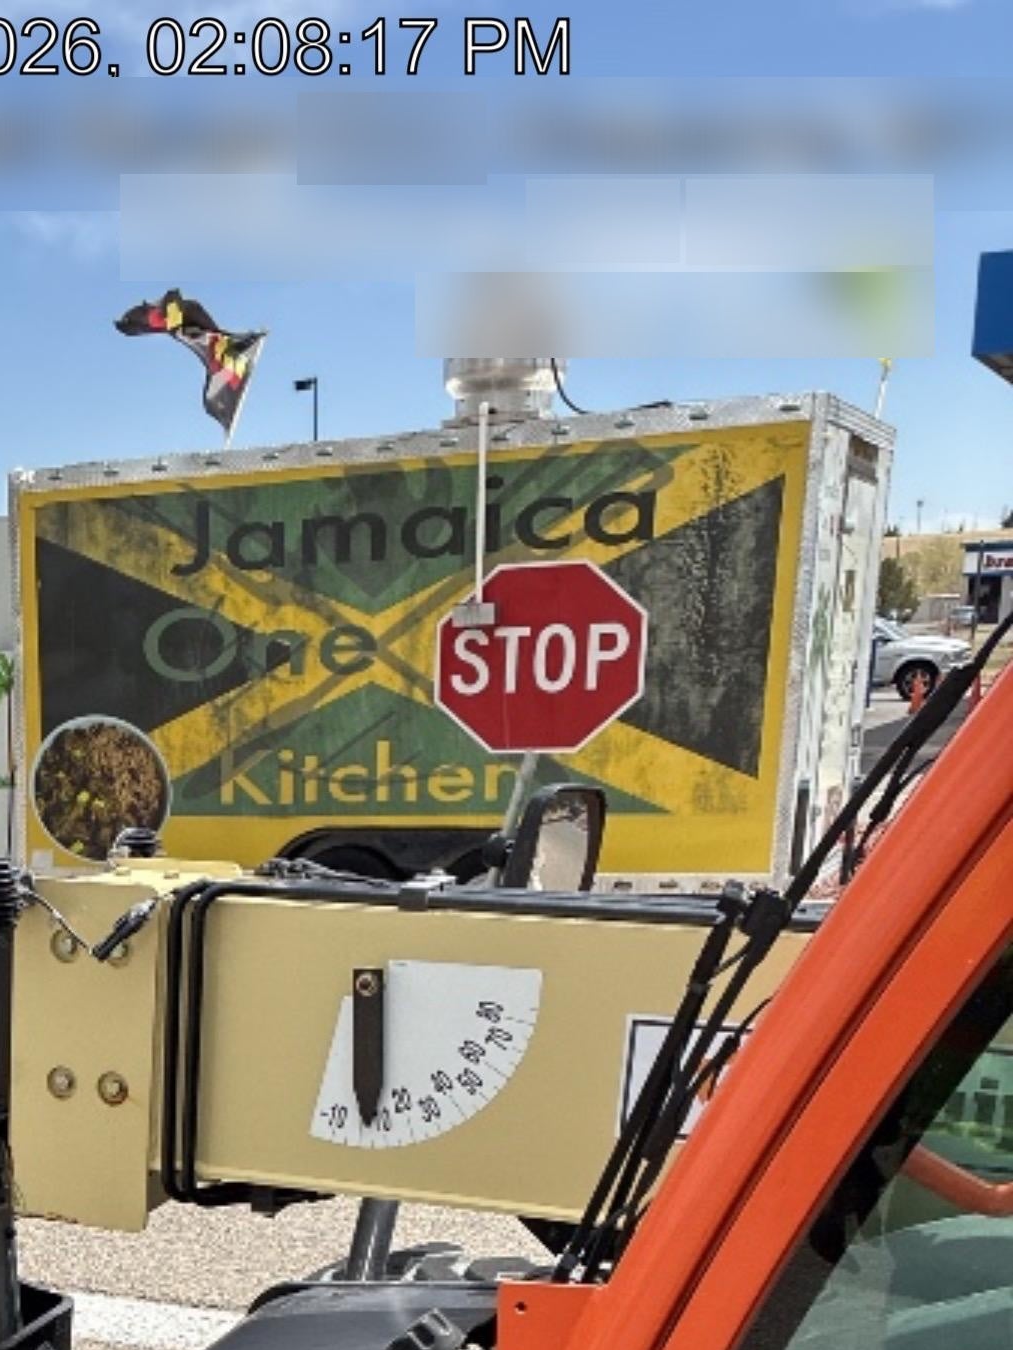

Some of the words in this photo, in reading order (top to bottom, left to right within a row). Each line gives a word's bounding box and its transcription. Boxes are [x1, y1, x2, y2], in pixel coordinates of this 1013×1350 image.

[170, 474, 657, 577] Jamaica
[142, 607, 377, 682] One
[450, 623, 630, 695] STOP
[475, 1000, 504, 1023] 80
[484, 1026, 513, 1050] 70
[458, 1039, 486, 1065] 60
[431, 1070, 453, 1096] 40
[455, 1068, 483, 1096] 50
[391, 1087, 411, 1114] 20
[417, 1095, 441, 1123] 30
